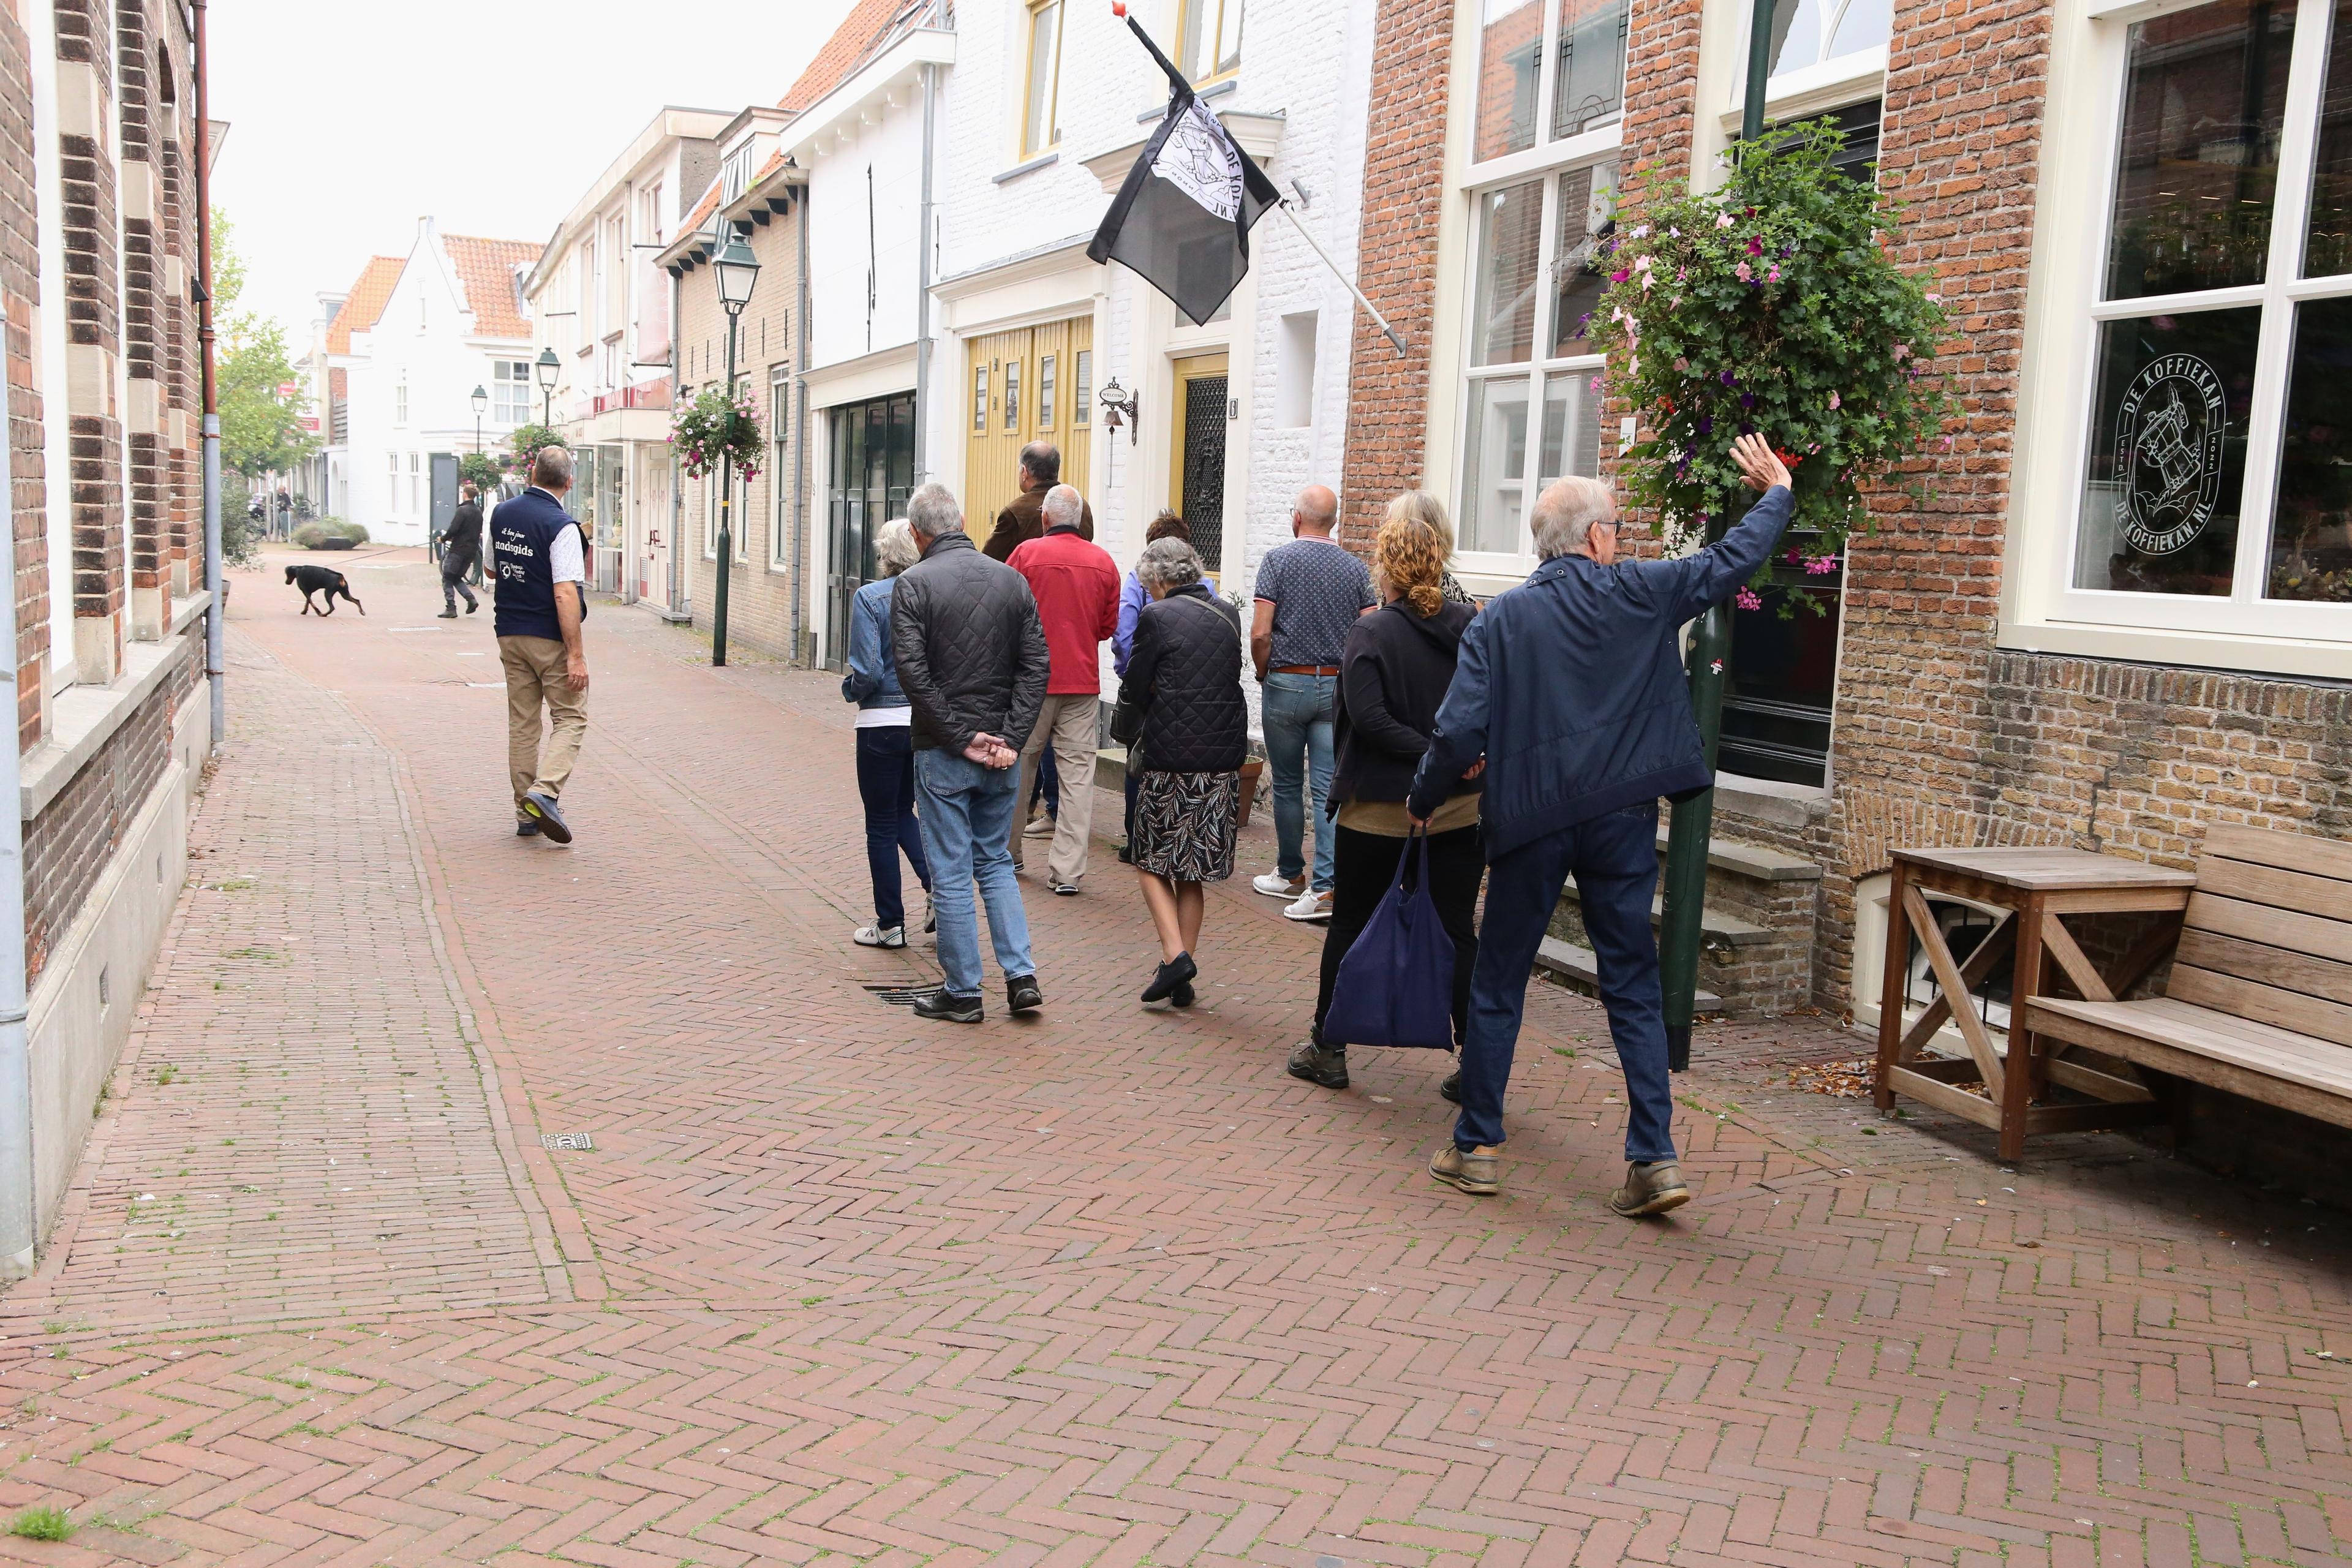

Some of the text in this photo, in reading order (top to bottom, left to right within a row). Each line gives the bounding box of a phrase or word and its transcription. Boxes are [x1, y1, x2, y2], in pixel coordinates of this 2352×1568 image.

[2124, 358, 2222, 413] DE KOFFIEKAN
[1231, 401, 1235, 416] 6
[2115, 500, 2211, 551] DE KOFFIEKAN.NL
[495, 540, 533, 557] stadsgids
